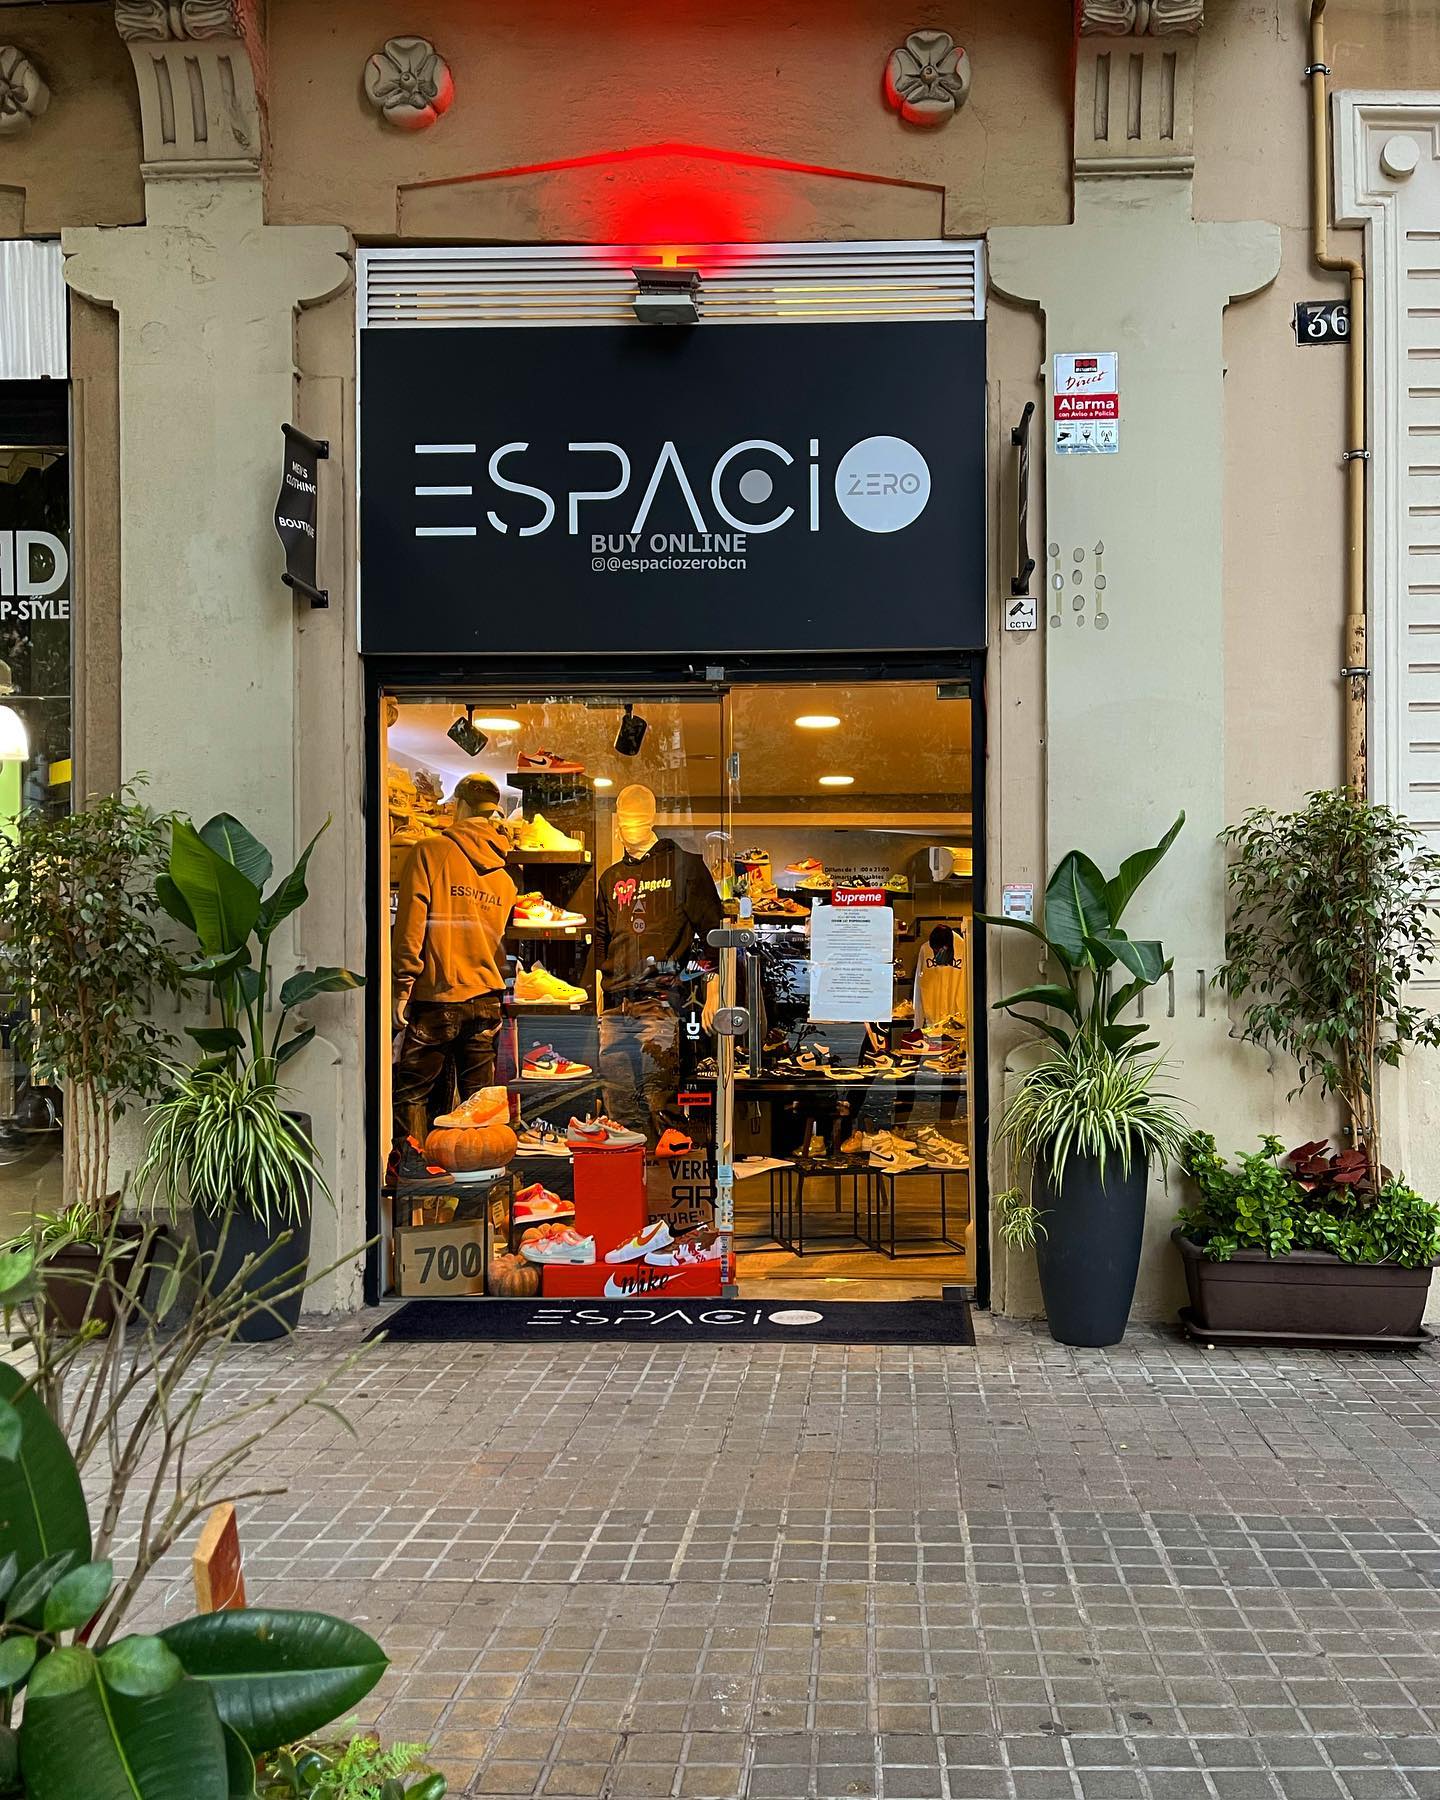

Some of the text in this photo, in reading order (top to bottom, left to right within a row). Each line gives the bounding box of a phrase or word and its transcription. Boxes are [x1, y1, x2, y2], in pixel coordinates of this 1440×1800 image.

[1306, 305, 1350, 337] 36
[1065, 371, 1108, 390] Direct
[1059, 397, 1115, 410] Alarma
[847, 472, 921, 495] ZERO
[591, 533, 747, 553] BUY ONLINE
[606, 556, 747, 572] @espaciozerobcn
[0, 600, 69, 620] P-STYLE
[1010, 621, 1032, 629] CCTV
[638, 877, 672, 893] Angels
[834, 891, 882, 905] Supreme
[414, 1242, 482, 1284] 700
[621, 1268, 674, 1295] nike
